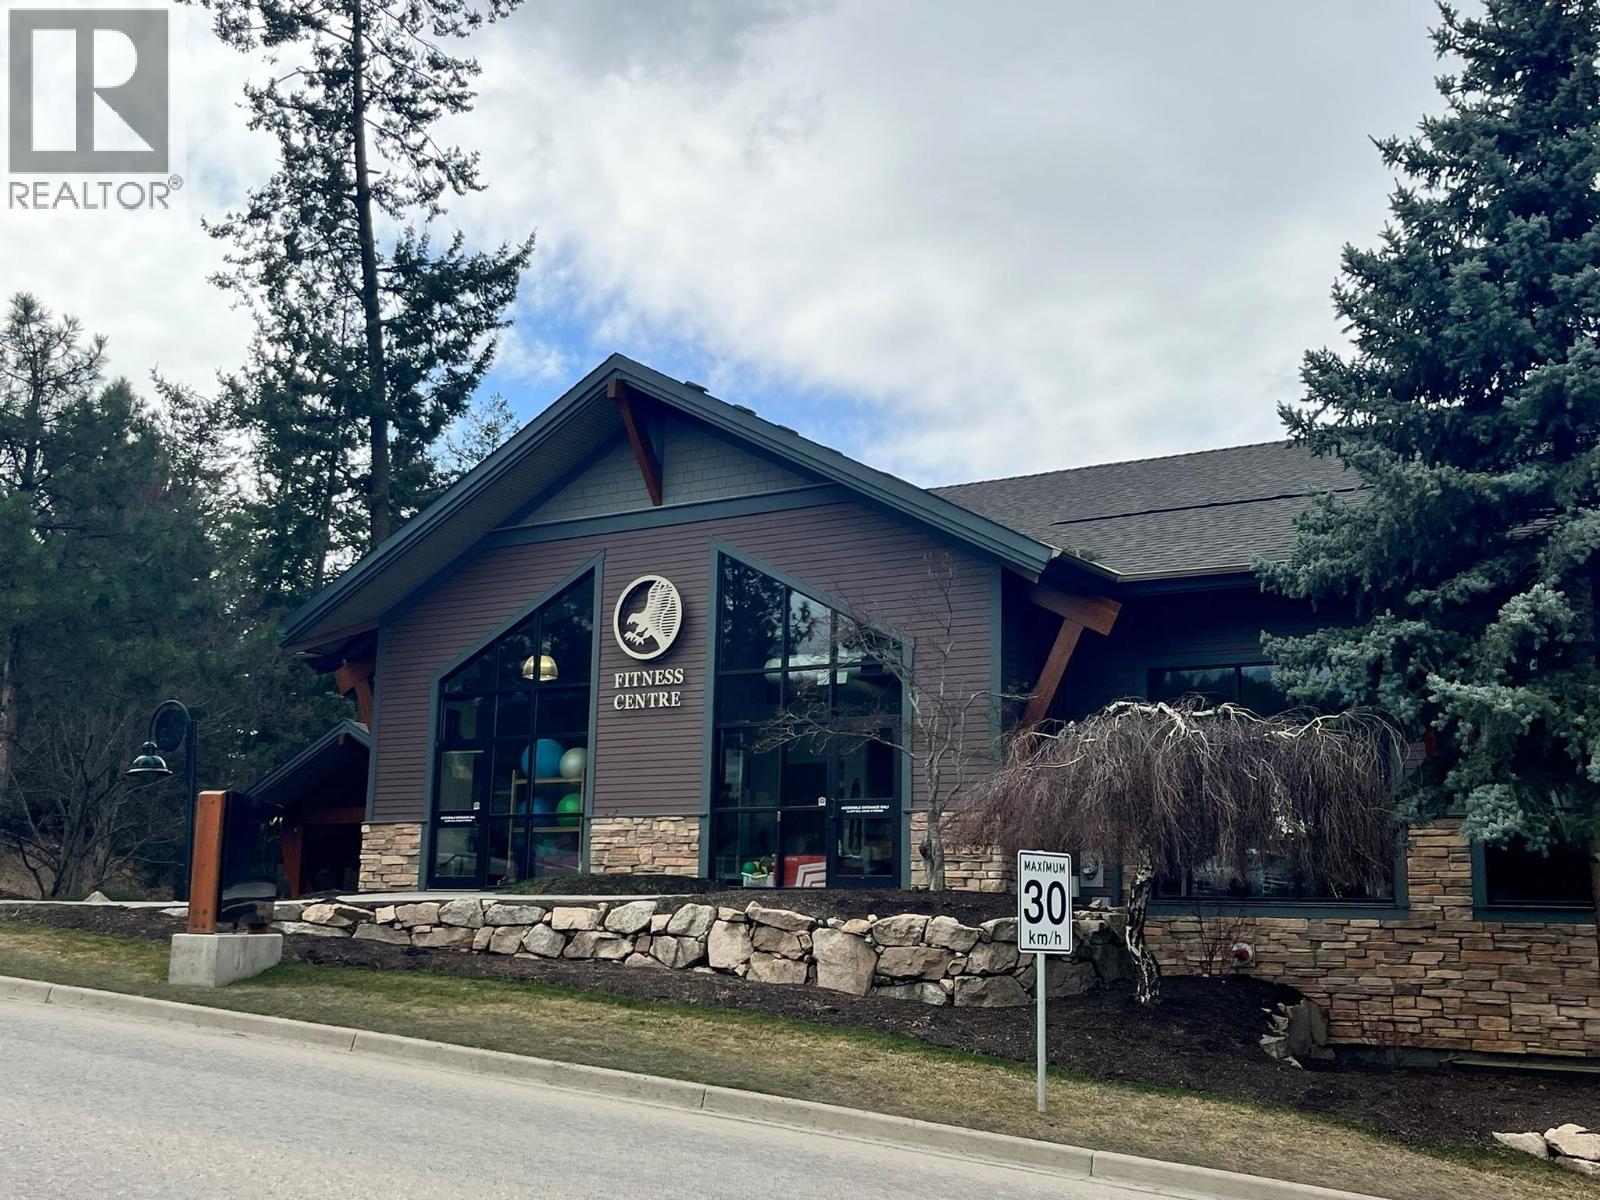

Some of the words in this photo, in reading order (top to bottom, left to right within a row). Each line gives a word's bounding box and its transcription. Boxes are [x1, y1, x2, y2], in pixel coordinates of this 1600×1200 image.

[614, 668, 684, 689] FITNESS
[613, 691, 681, 710] CENTRE
[1024, 860, 1066, 874] MAXIMUM
[1023, 879, 1067, 926] 30
[1028, 929, 1062, 947] km/h
